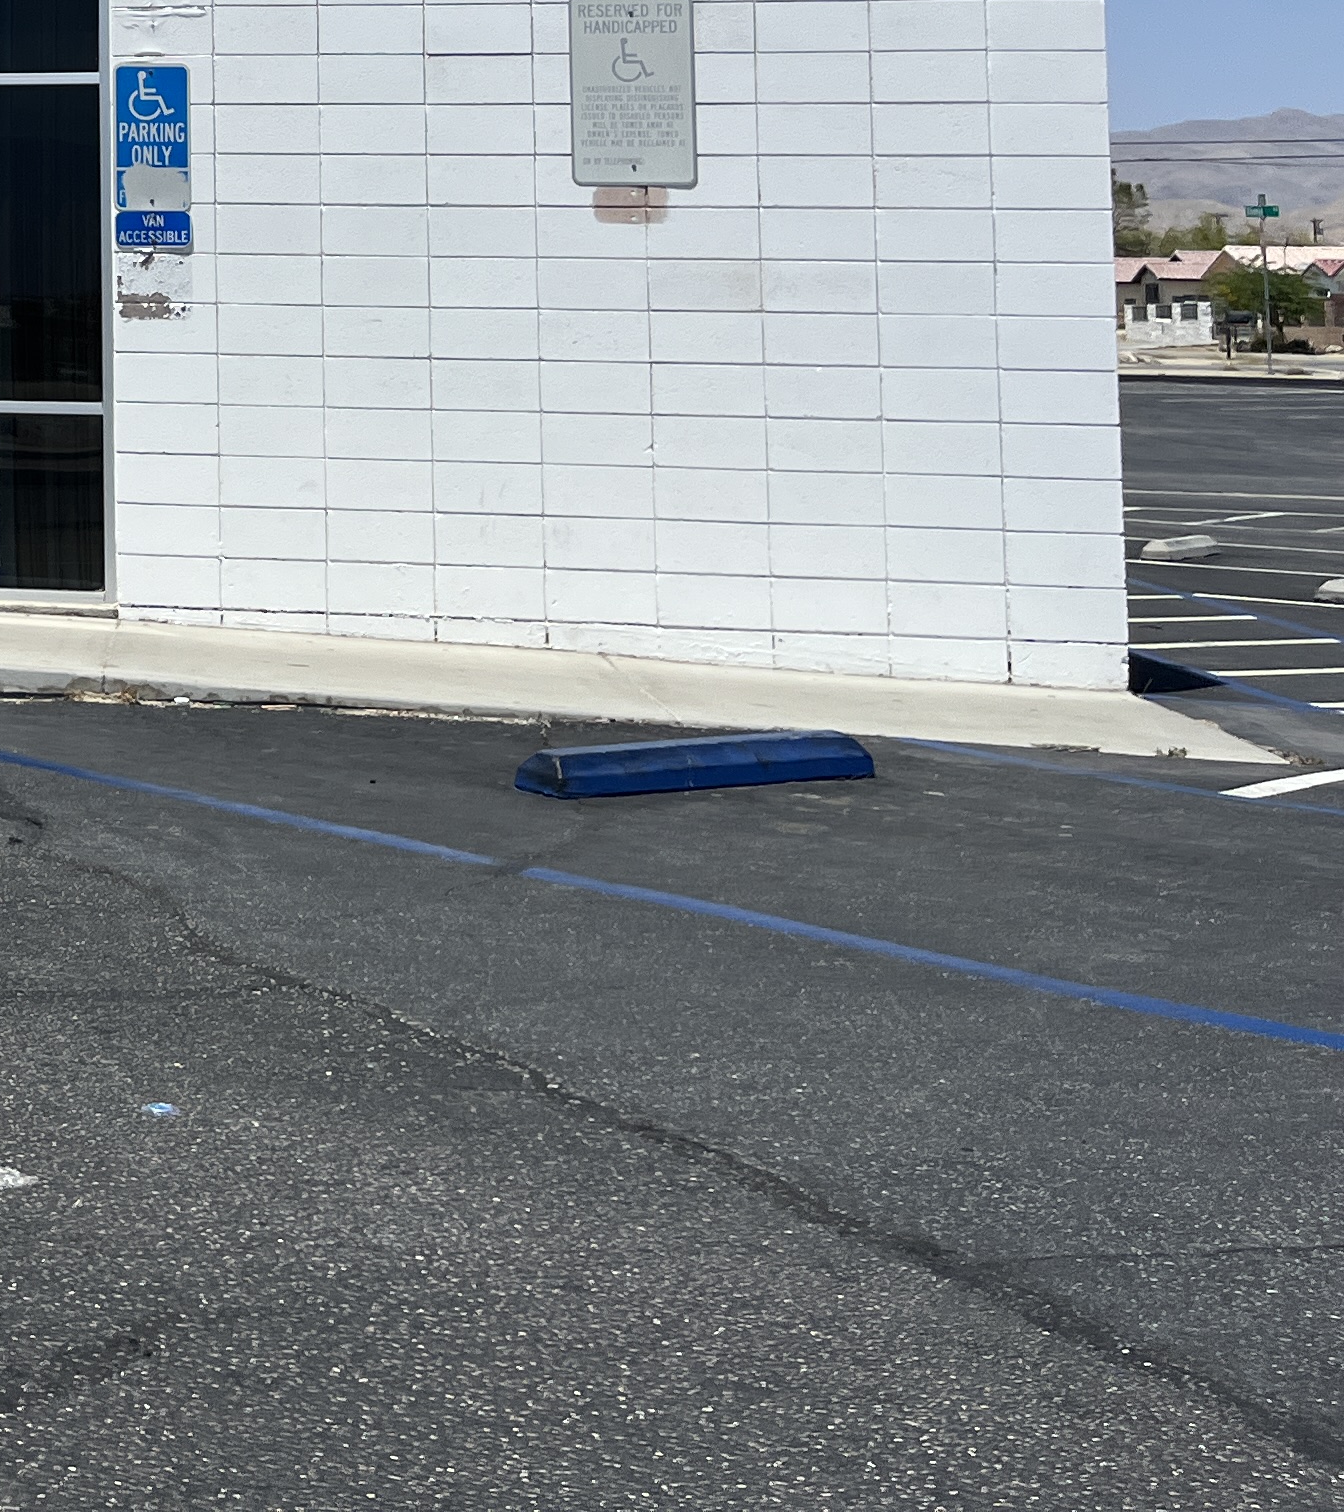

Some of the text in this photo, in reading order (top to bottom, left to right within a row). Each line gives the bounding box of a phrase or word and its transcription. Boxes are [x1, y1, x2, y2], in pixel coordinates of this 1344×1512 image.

[578, 3, 683, 18] RESERVED FOR
[584, 20, 678, 34] HANDICAPPED
[118, 122, 185, 143] PARKING
[131, 144, 173, 166] ONLY
[141, 214, 164, 227] VAN
[118, 230, 189, 243] ACCESSIBLE
